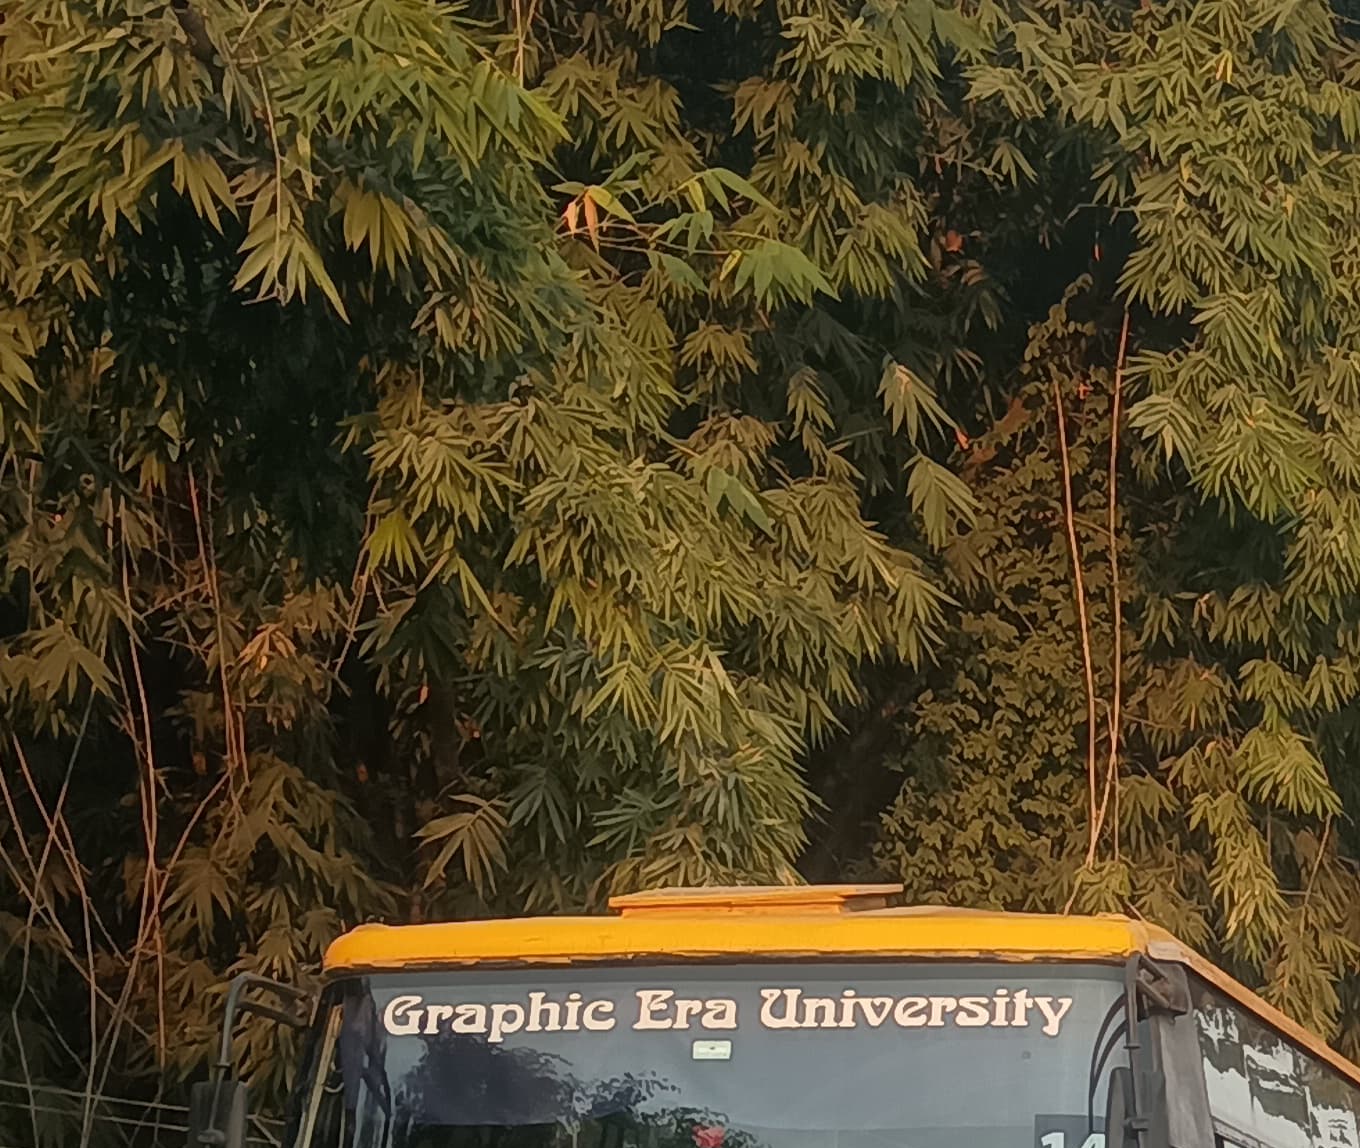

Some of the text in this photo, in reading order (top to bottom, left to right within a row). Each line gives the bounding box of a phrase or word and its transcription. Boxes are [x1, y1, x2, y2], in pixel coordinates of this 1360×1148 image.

[383, 988, 1073, 1043] Graphic Era University
